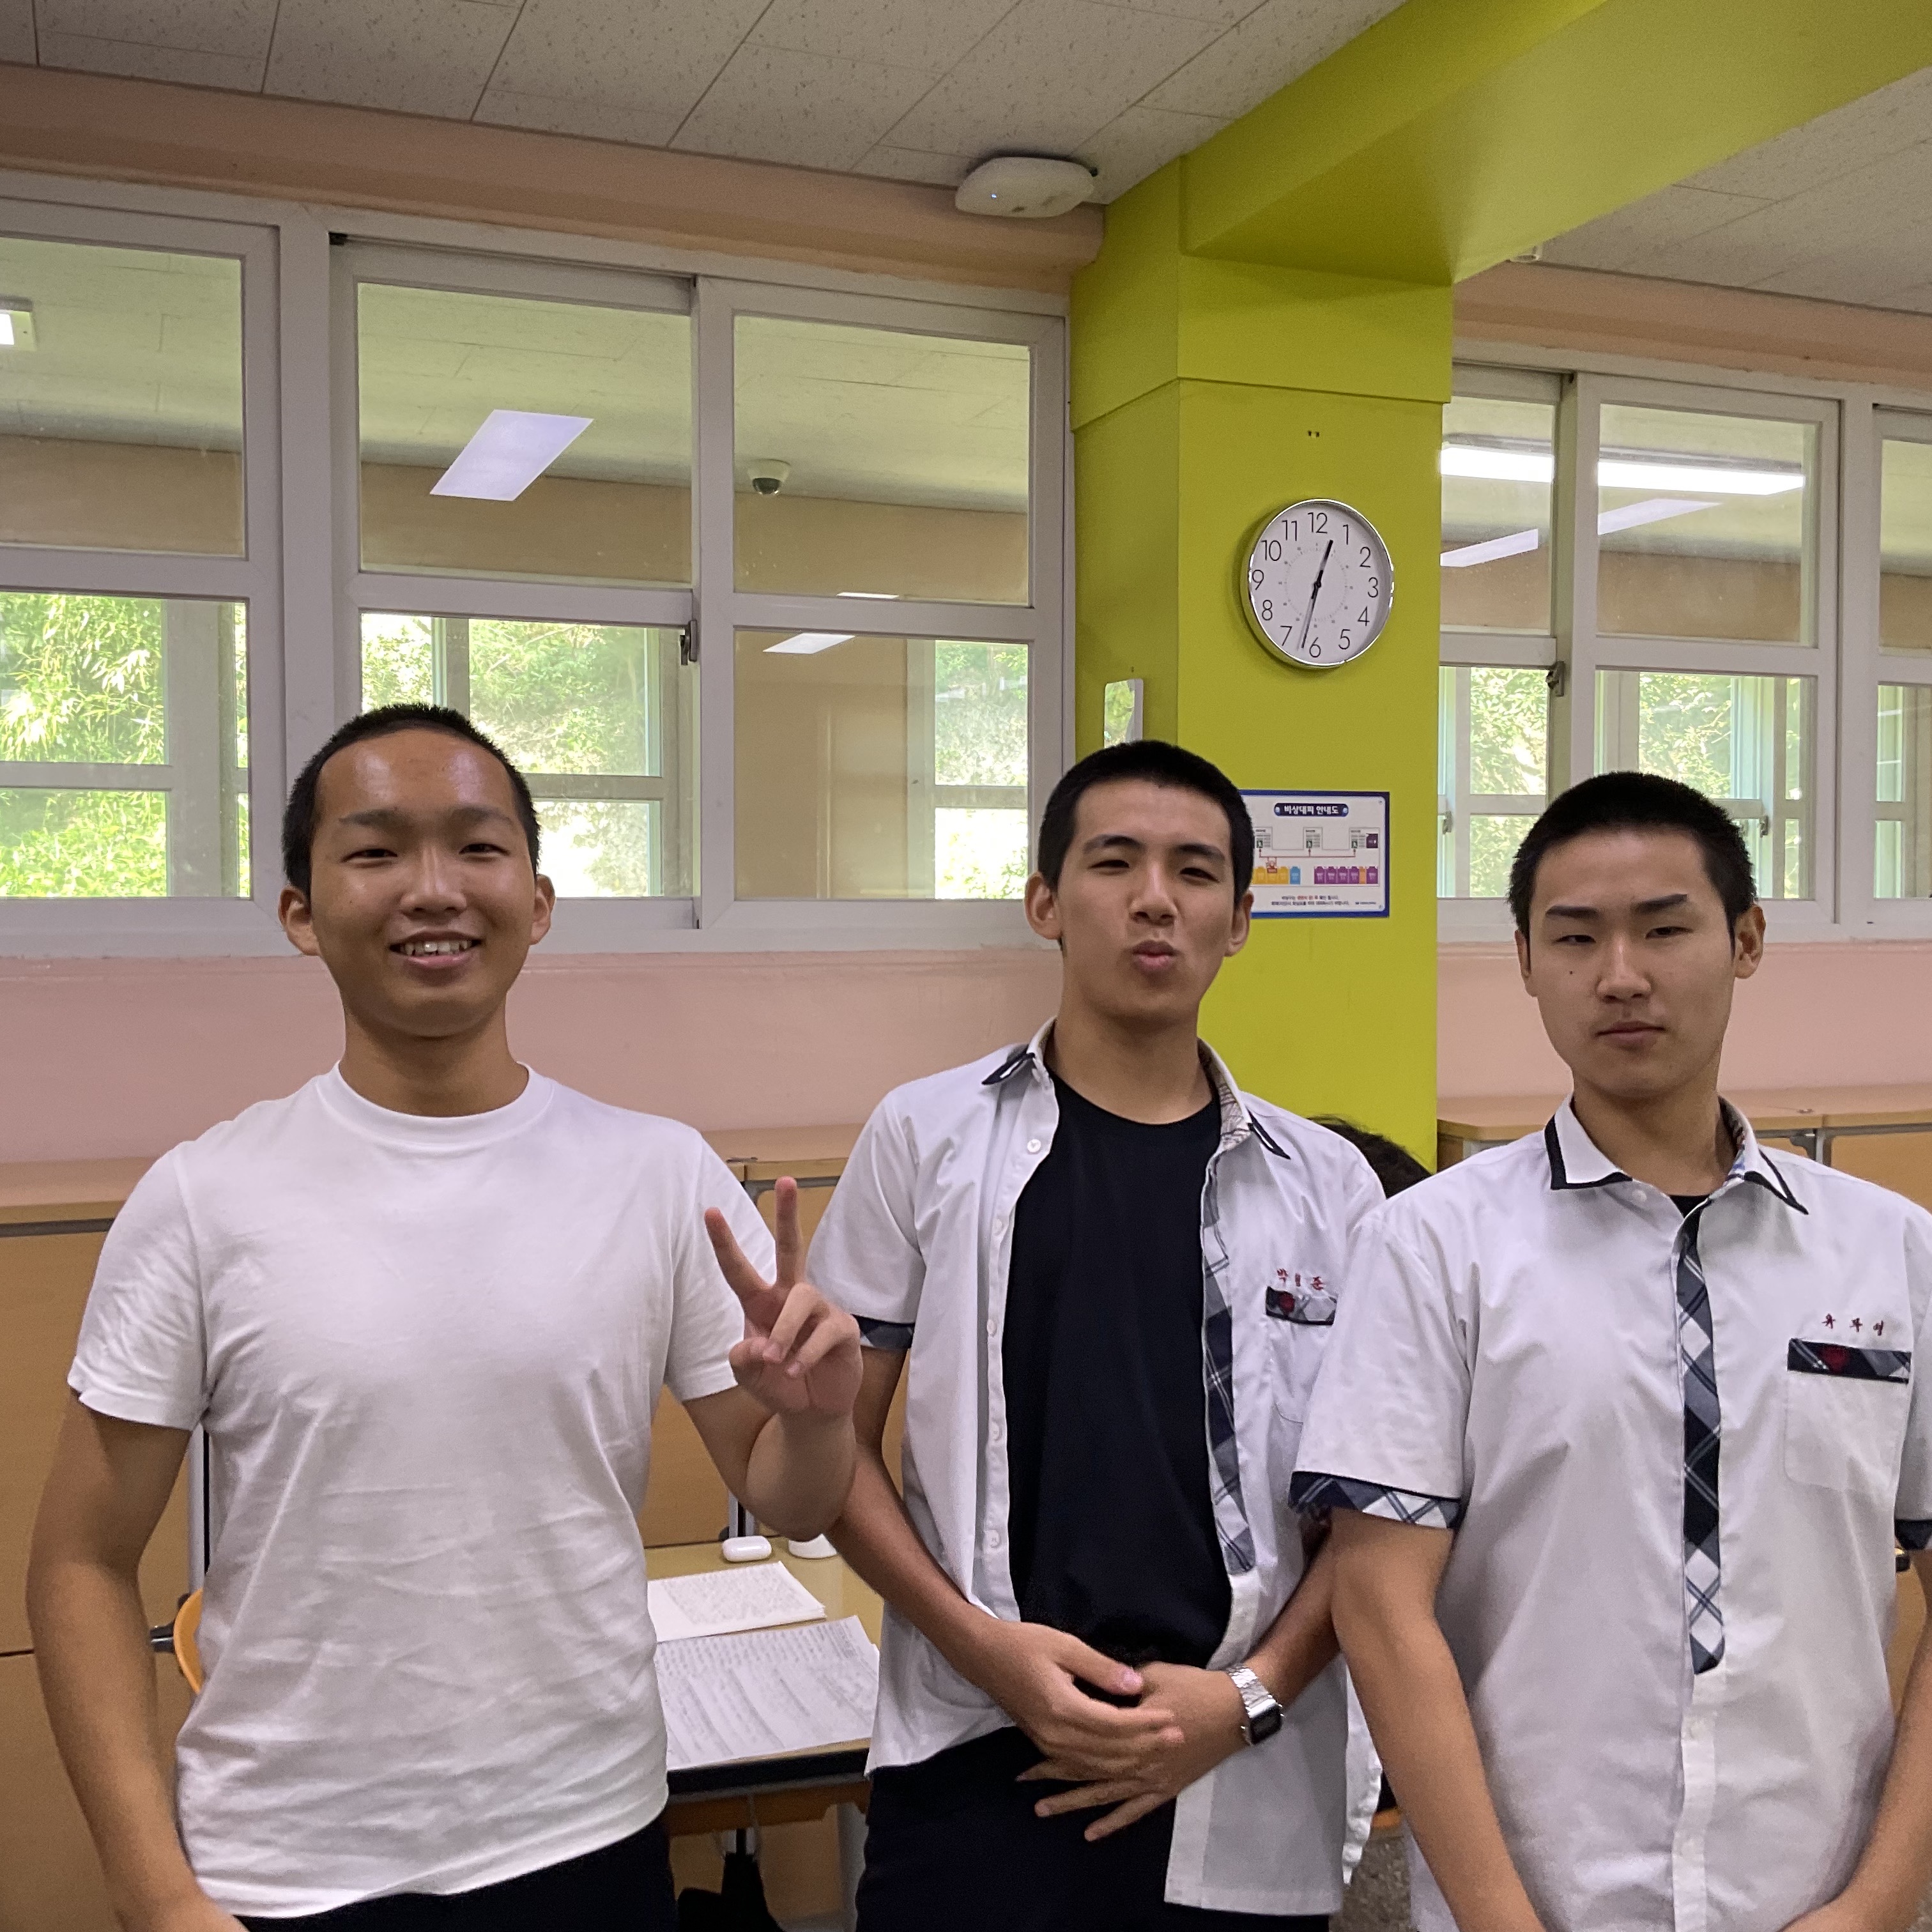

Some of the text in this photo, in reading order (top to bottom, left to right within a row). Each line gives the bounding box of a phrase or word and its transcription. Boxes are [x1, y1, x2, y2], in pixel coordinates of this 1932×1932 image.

[1282, 519, 1298, 541] 11
[1308, 512, 1328, 534] 12
[1342, 524, 1349, 545] 1
[1261, 540, 1282, 562] 10
[1360, 546, 1371, 568] 2
[1252, 569, 1264, 590] 9
[1367, 577, 1379, 598] 3
[1261, 599, 1273, 621] 8
[1358, 606, 1370, 626] 4
[1280, 625, 1292, 646] 7
[1338, 629, 1351, 650] 5
[1309, 636, 1321, 657] 6
[1284, 805, 1339, 815] 비상대피 안내도
